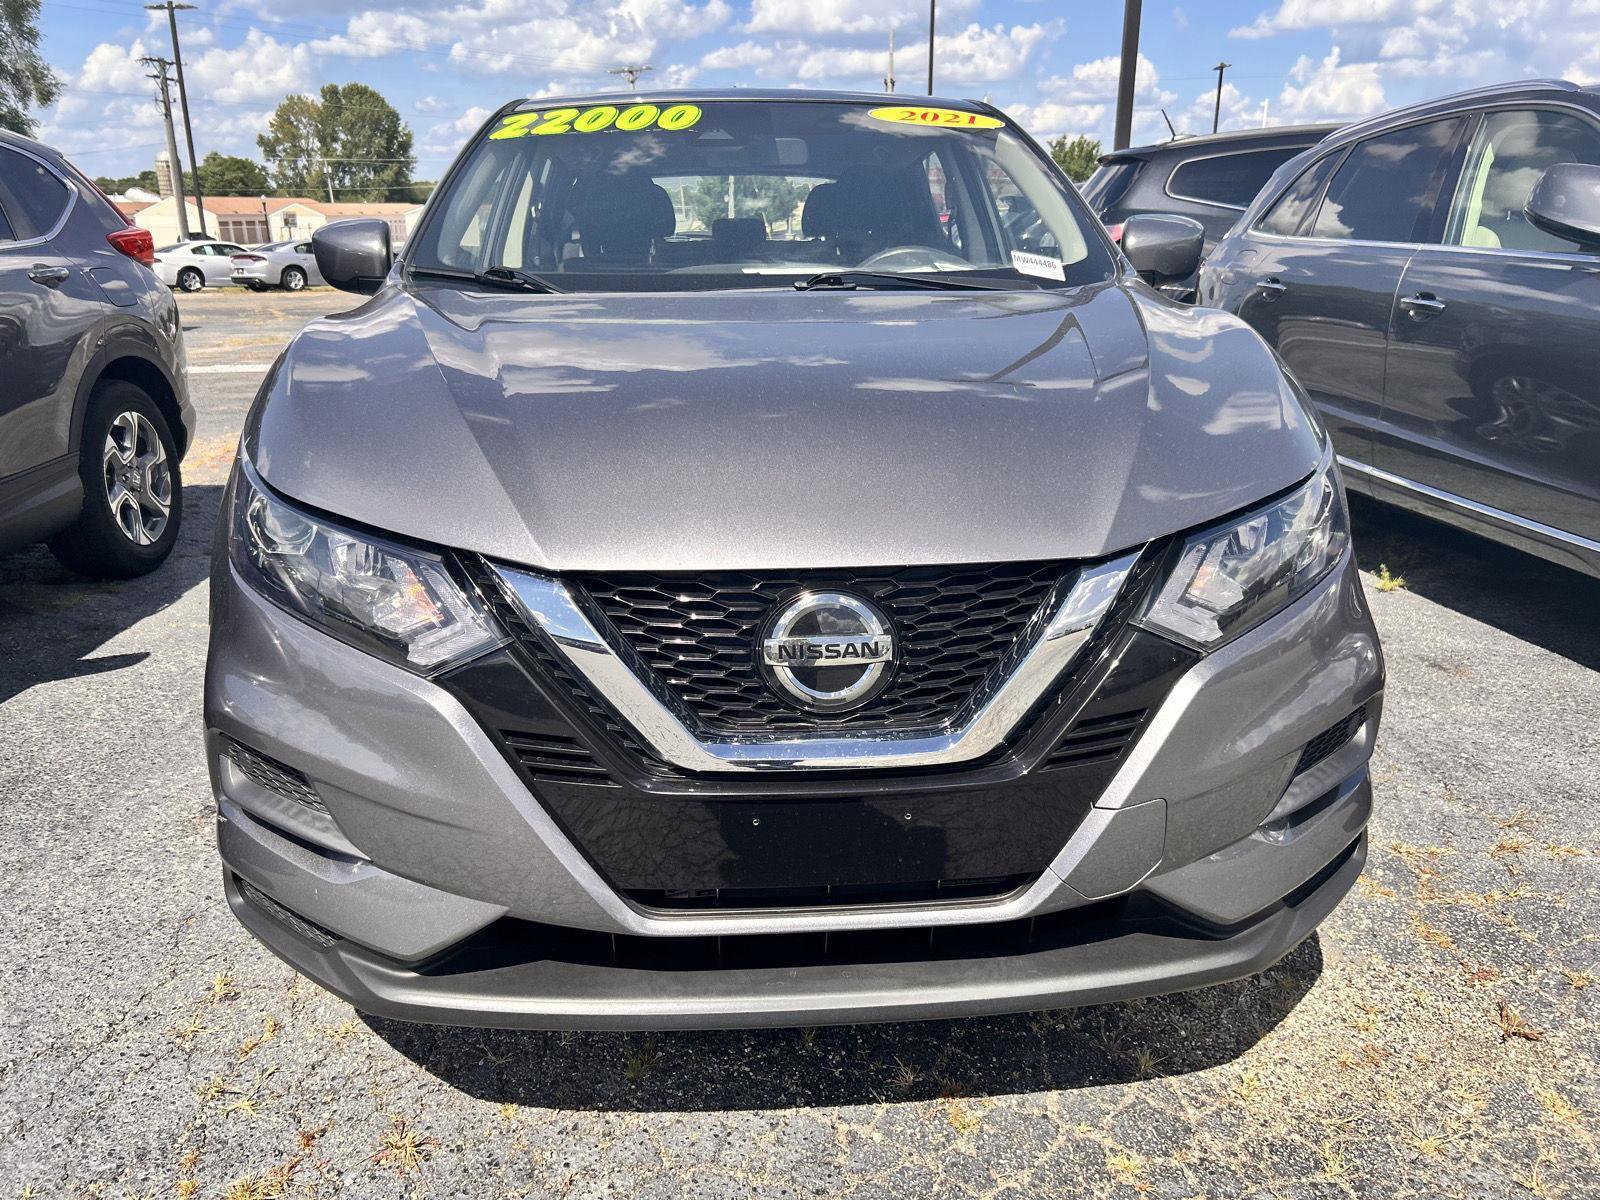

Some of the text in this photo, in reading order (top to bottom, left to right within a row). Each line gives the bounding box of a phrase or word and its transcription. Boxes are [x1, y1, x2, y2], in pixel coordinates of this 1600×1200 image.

[489, 105, 702, 140] 22000
[900, 111, 976, 125] 2021
[778, 641, 879, 660] NISSAN
